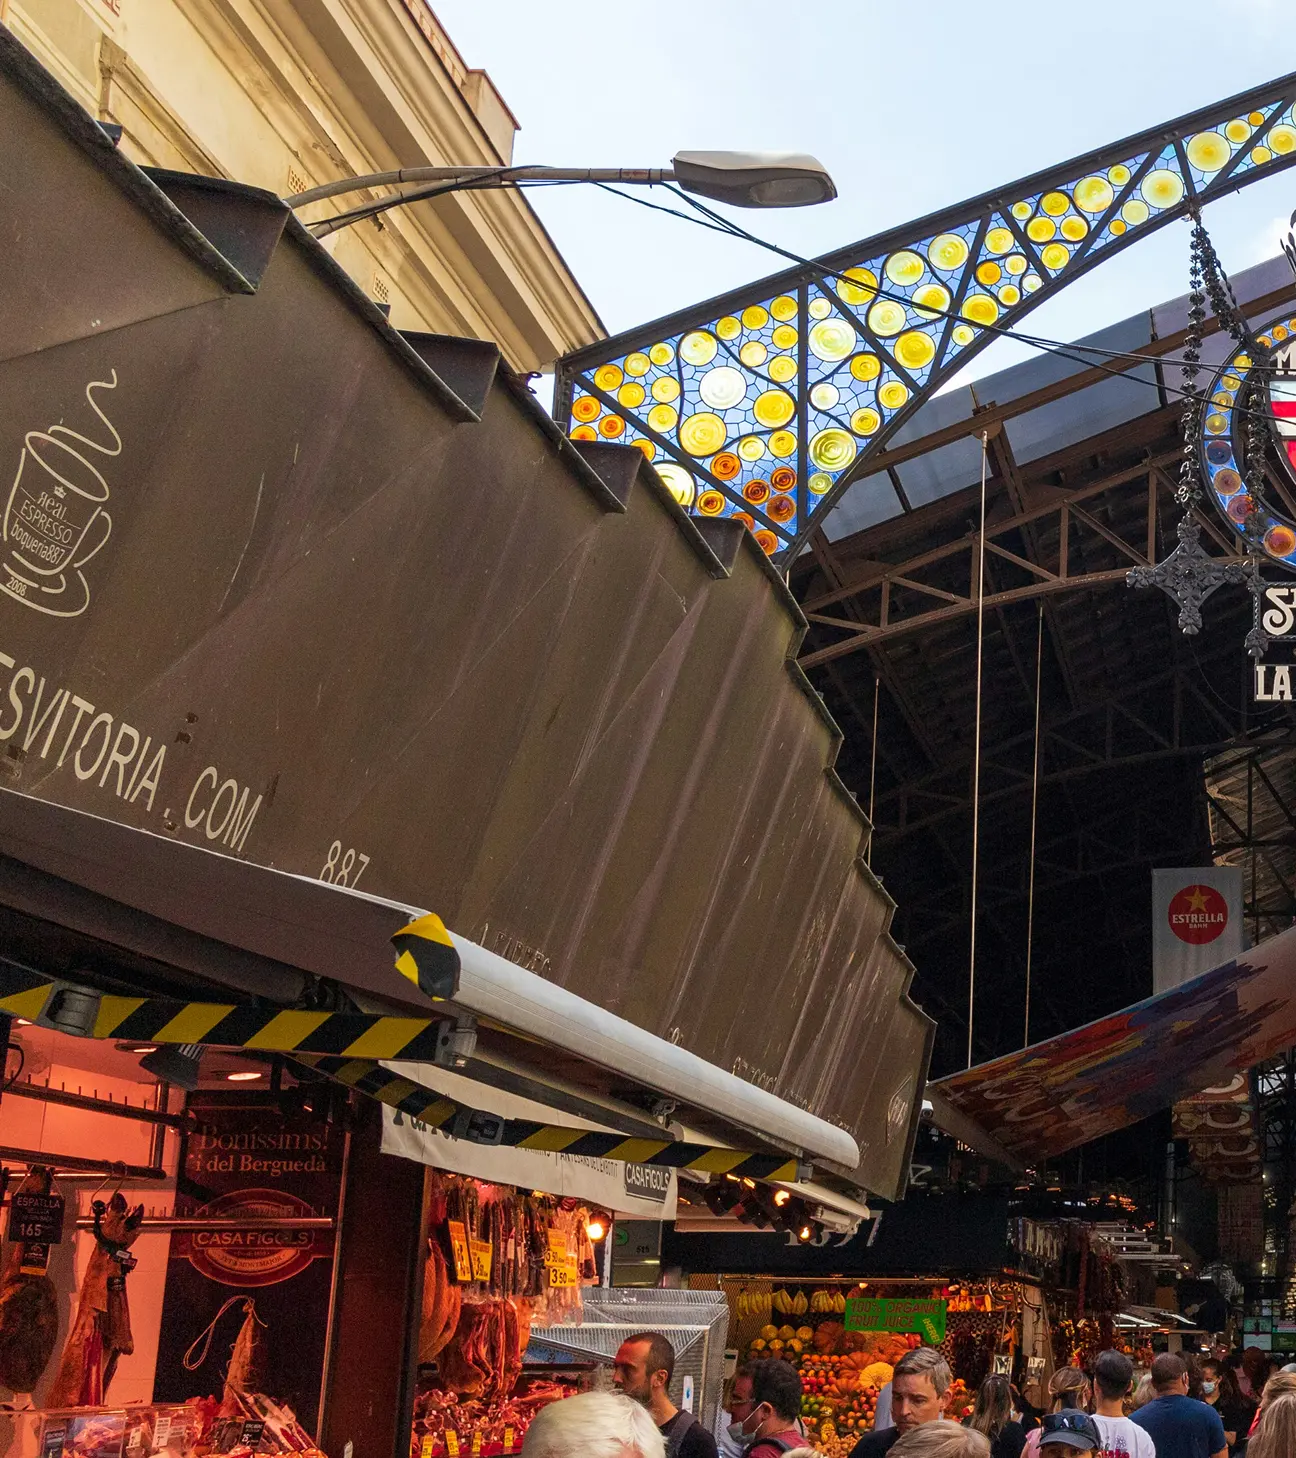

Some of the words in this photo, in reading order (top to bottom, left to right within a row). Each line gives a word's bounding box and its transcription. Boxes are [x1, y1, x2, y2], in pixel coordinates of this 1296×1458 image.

[20, 499, 73, 544] ESPRESSO
[10, 517, 66, 565] boqueria887
[6, 576, 28, 597] 2008
[1256, 665, 1292, 700] LA
[184, 766, 263, 852] COM
[319, 840, 370, 889] 887
[1172, 912, 1224, 924] ESTRELLA
[206, 1154, 234, 1172] del
[239, 1154, 326, 1177] Berguedà
[626, 1163, 646, 1188] CASA
[197, 1231, 244, 1245] CASA
[852, 1301, 882, 1313] 100%
[886, 1301, 942, 1315] ORGANIC
[849, 1315, 880, 1327] FRUIT
[882, 1315, 916, 1328] JUICE
